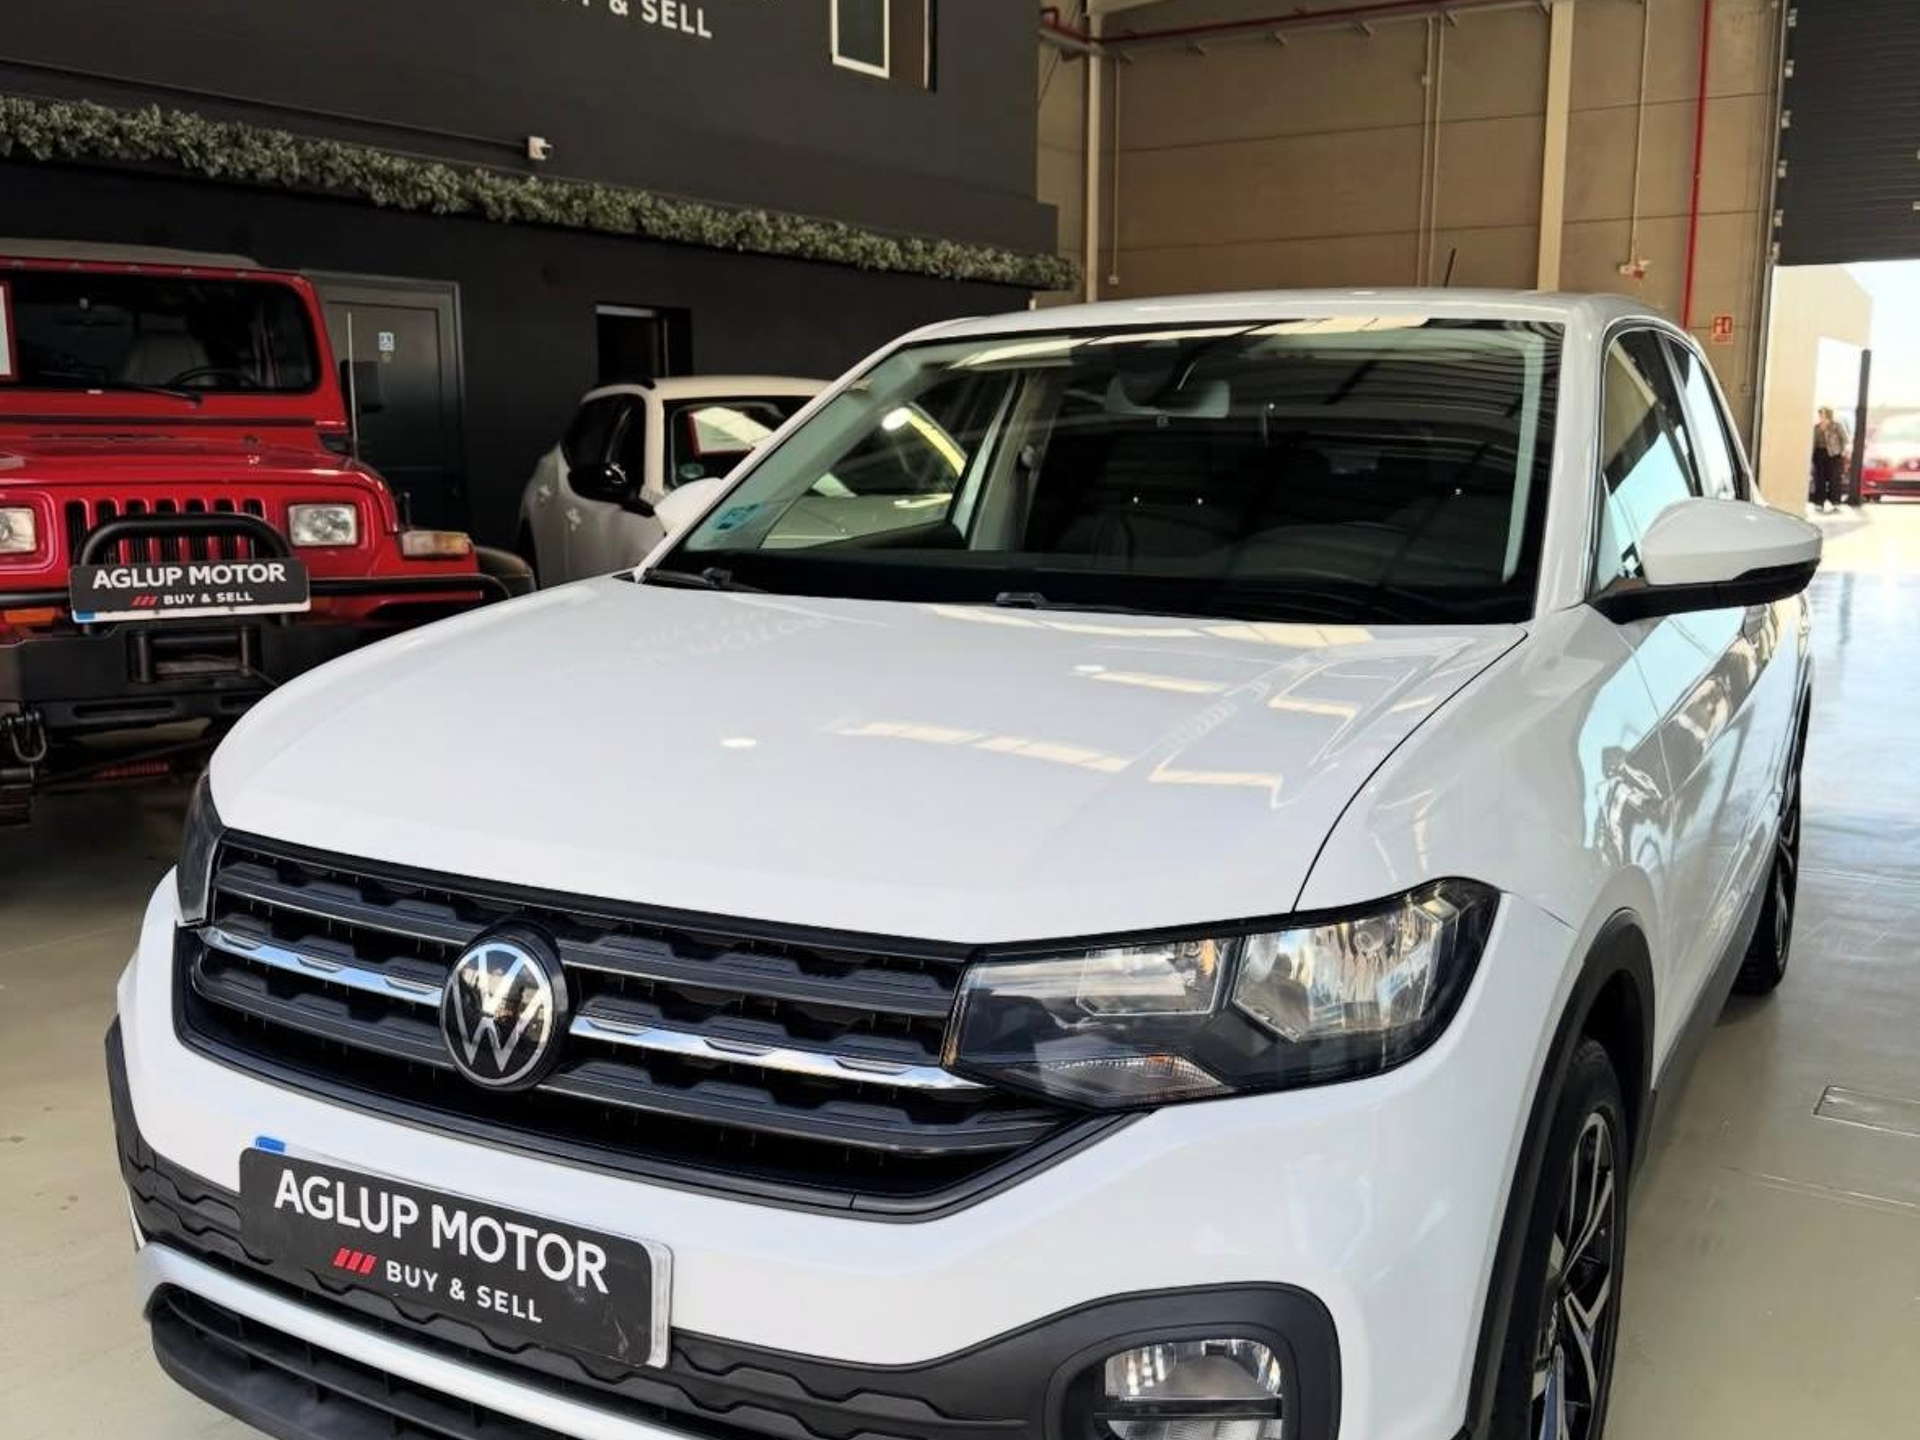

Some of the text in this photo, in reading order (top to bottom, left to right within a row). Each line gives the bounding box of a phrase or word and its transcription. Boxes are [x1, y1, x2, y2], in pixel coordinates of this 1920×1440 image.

[642, 0, 712, 39] SELL
[93, 563, 286, 589] AGLUP MOTOR
[163, 591, 253, 605] BUY & SELL
[273, 1169, 609, 1294] AGLUP MOTOR
[385, 1260, 543, 1323] BUY & SELL
